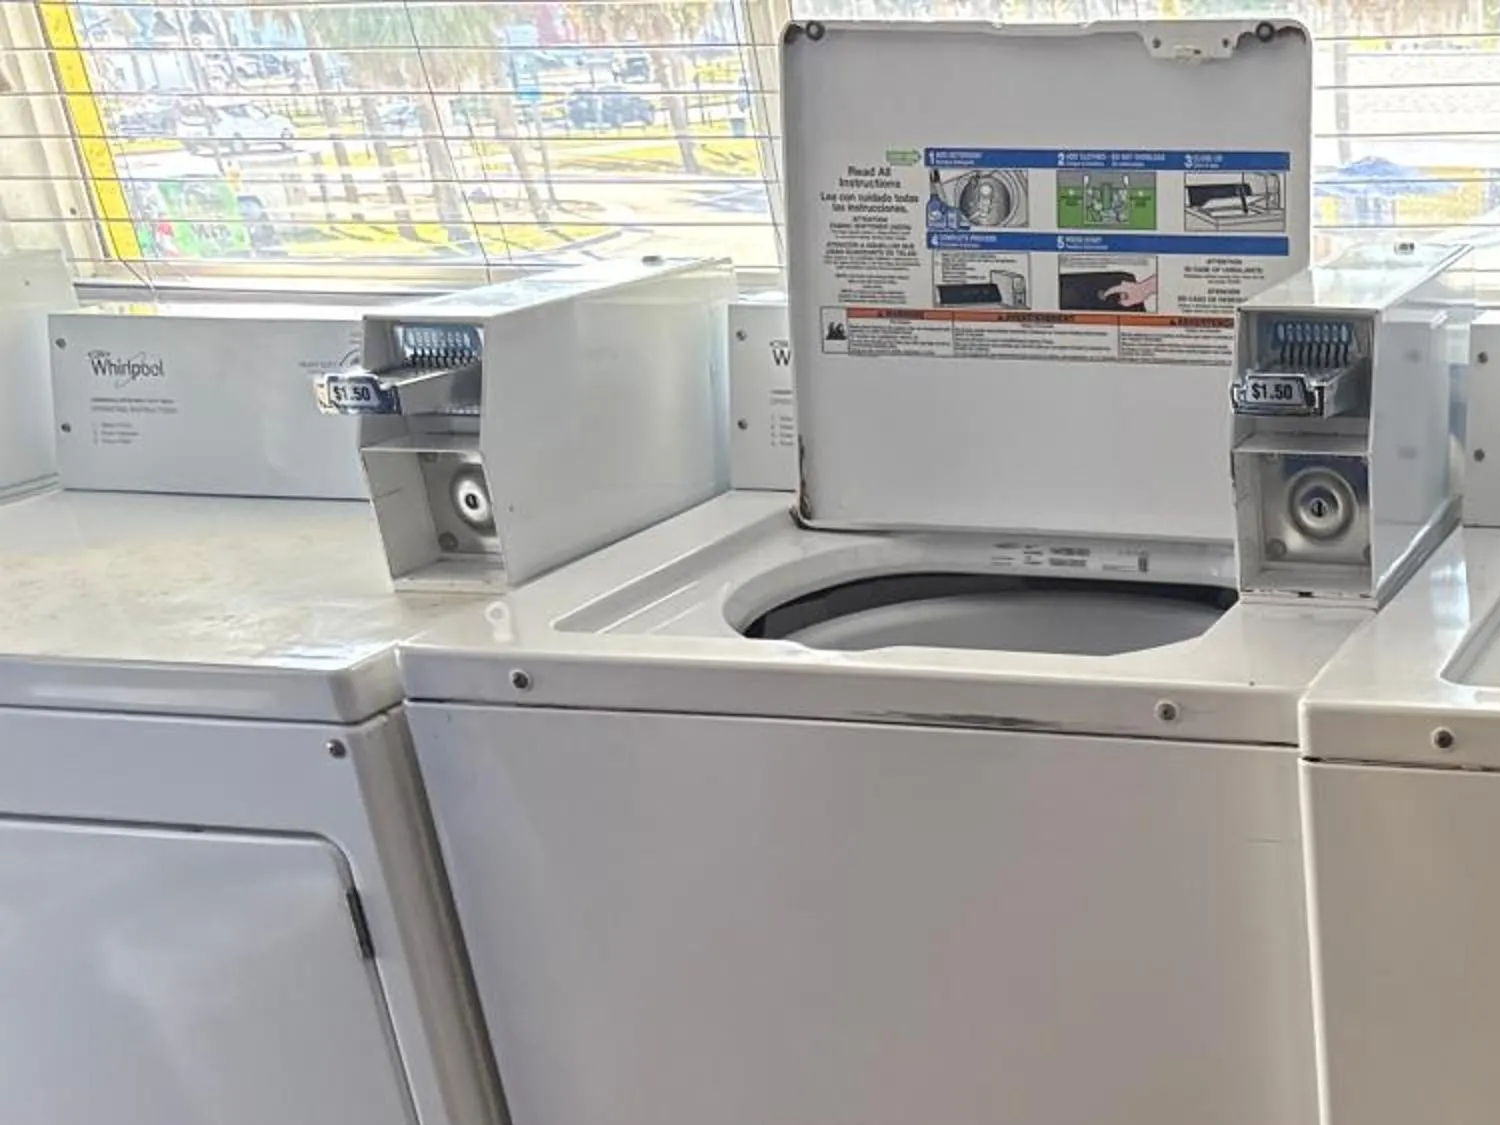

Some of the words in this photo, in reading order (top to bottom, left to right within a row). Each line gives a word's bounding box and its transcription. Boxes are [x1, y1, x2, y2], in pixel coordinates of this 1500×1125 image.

[848, 165, 875, 177] Read
[878, 166, 892, 177] All
[839, 178, 901, 189] Instructions
[91, 358, 165, 381] Whirlpool
[333, 384, 371, 401] $1.50
[1251, 383, 1293, 401] $1.50
